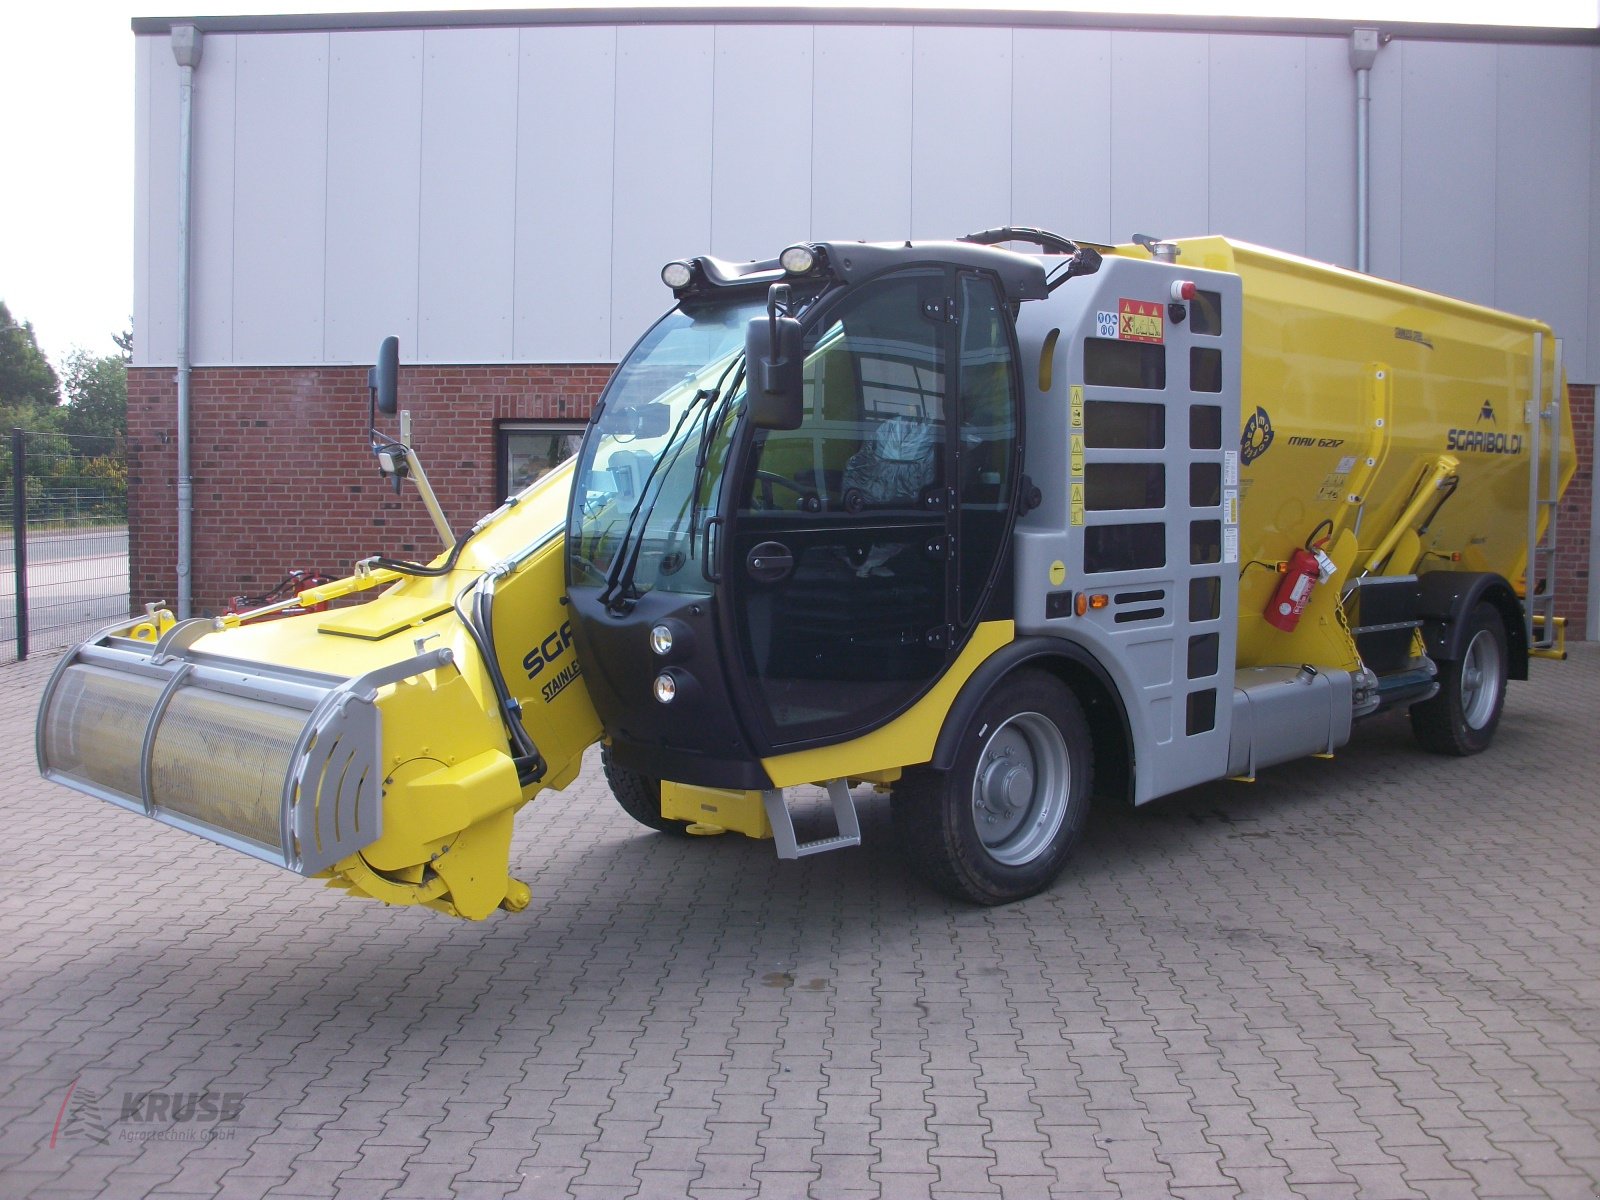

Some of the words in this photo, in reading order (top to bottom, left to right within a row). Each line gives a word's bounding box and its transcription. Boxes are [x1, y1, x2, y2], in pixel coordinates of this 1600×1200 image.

[1288, 436, 1316, 447] MAV
[1317, 437, 1345, 448] 6217
[1446, 428, 1522, 454] SGARIBOLDI
[541, 659, 581, 701] STAINLE
